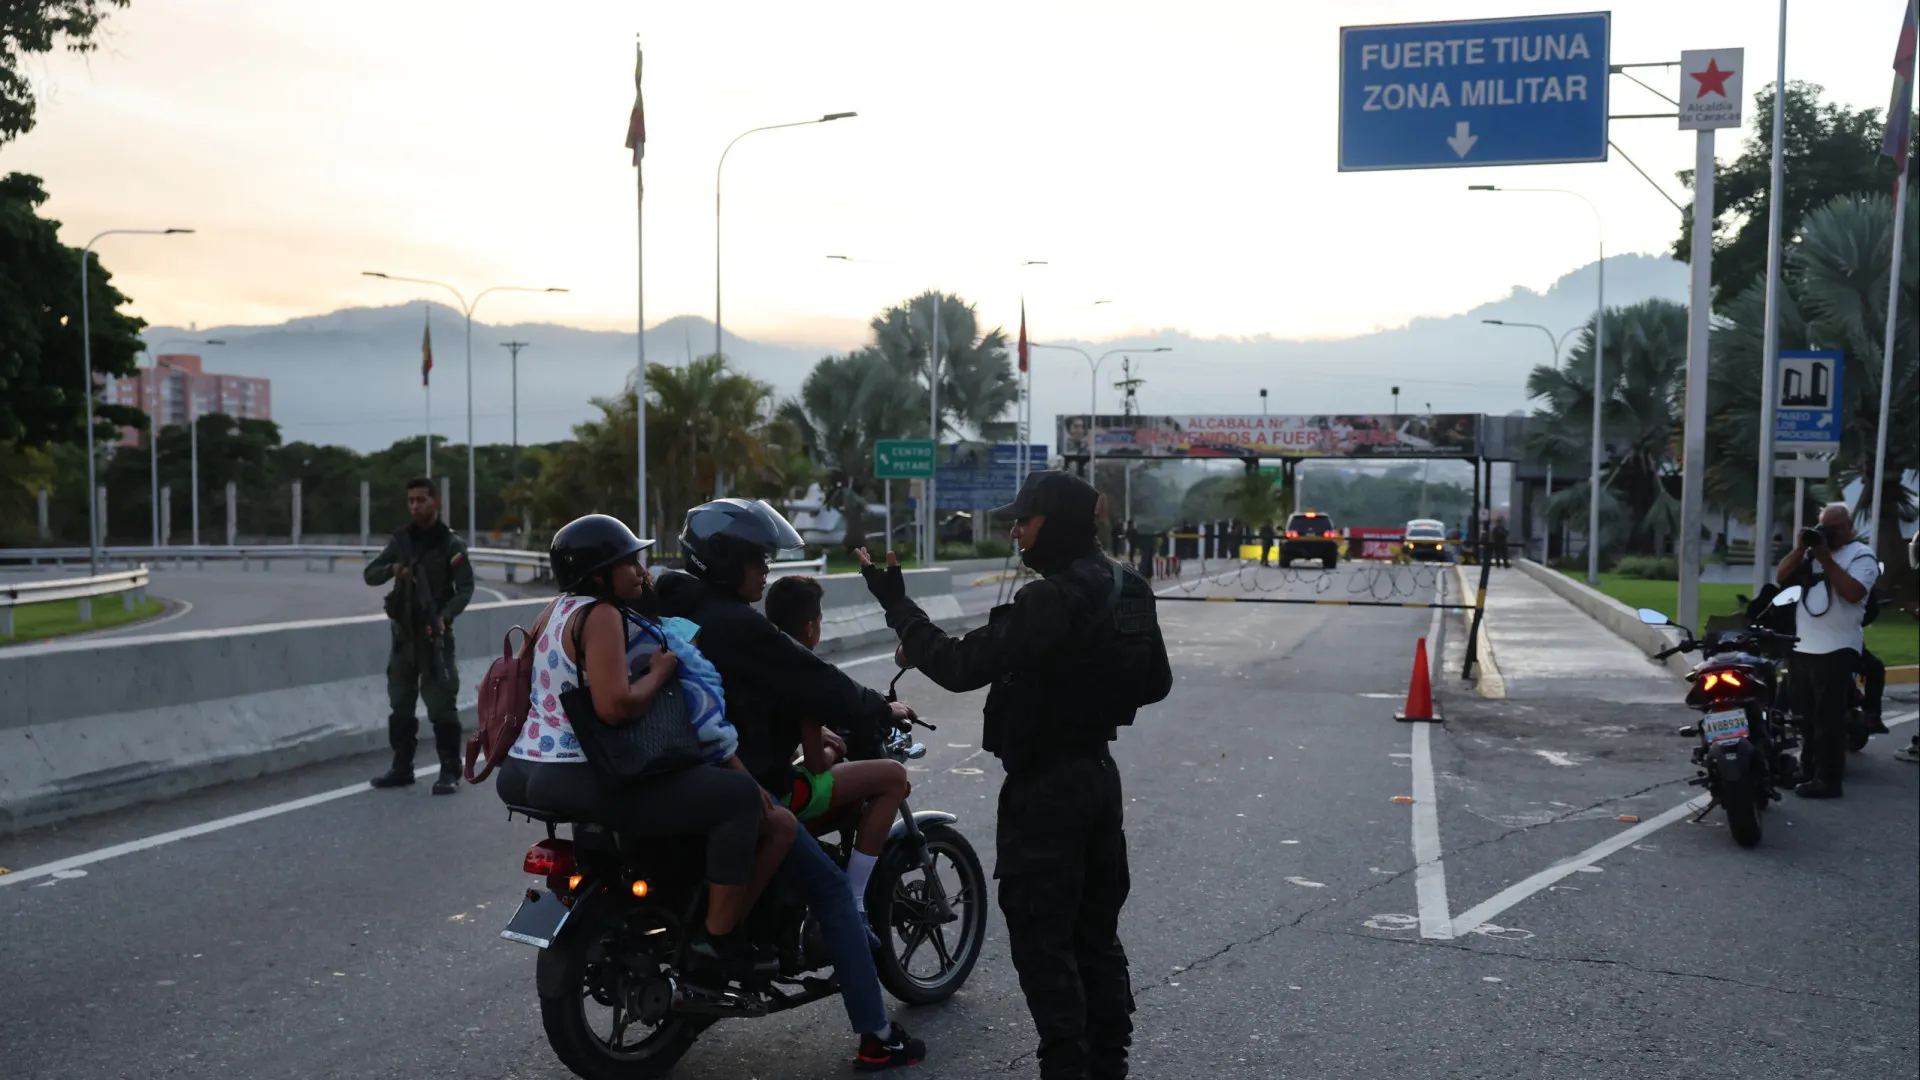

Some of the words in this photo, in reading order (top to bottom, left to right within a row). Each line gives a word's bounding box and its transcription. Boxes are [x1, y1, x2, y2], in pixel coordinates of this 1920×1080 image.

[1361, 38, 1485, 71] FUERTE
[1491, 33, 1591, 64] TIUNA
[1362, 82, 1451, 111] ZONA
[1460, 75, 1588, 107] MILITAR
[1680, 113, 1692, 122] de
[1695, 112, 1741, 122] Caracas
[1776, 412, 1811, 421] PASEO
[1188, 417, 1265, 429] ALCABALA
[1776, 421, 1797, 430] LOS
[1255, 431, 1268, 445] A
[1272, 431, 1339, 445] FUERTE
[891, 447, 932, 457] CENTRO
[893, 461, 930, 471] PETARE
